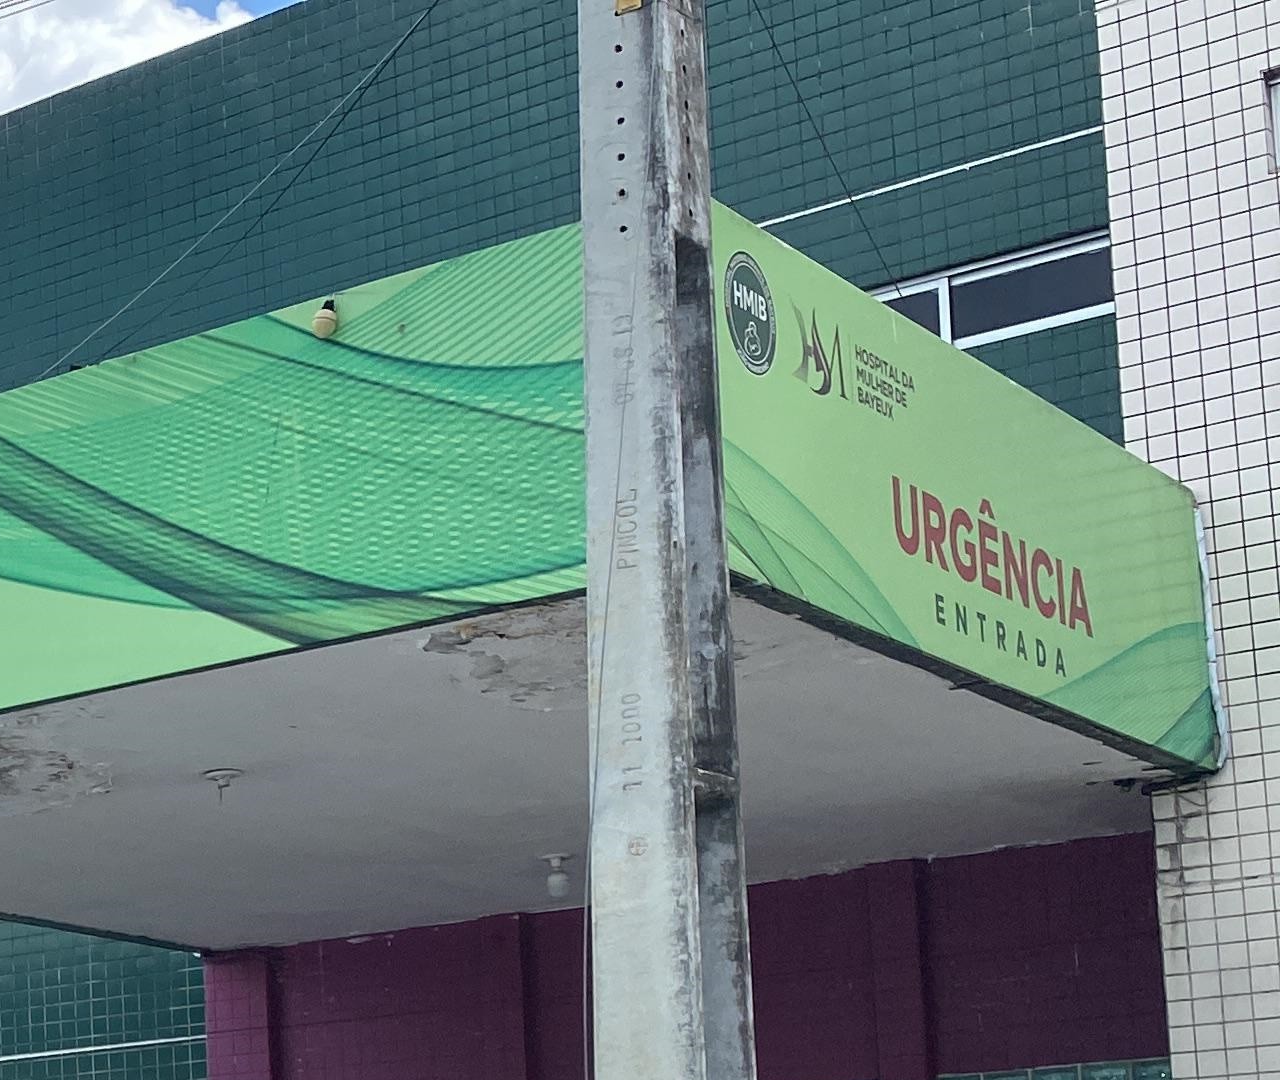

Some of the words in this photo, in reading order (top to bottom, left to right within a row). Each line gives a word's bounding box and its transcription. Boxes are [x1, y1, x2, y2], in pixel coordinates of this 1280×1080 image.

[732, 280, 768, 322] HMIB
[854, 344, 902, 385] HOSPITAL
[901, 374, 916, 393] DA
[855, 366, 895, 402] MULHER
[895, 391, 908, 409] DE
[857, 386, 895, 421] BAYEUX
[891, 474, 1095, 639] URGÊNCIA
[933, 593, 1069, 679] ENTRADA
